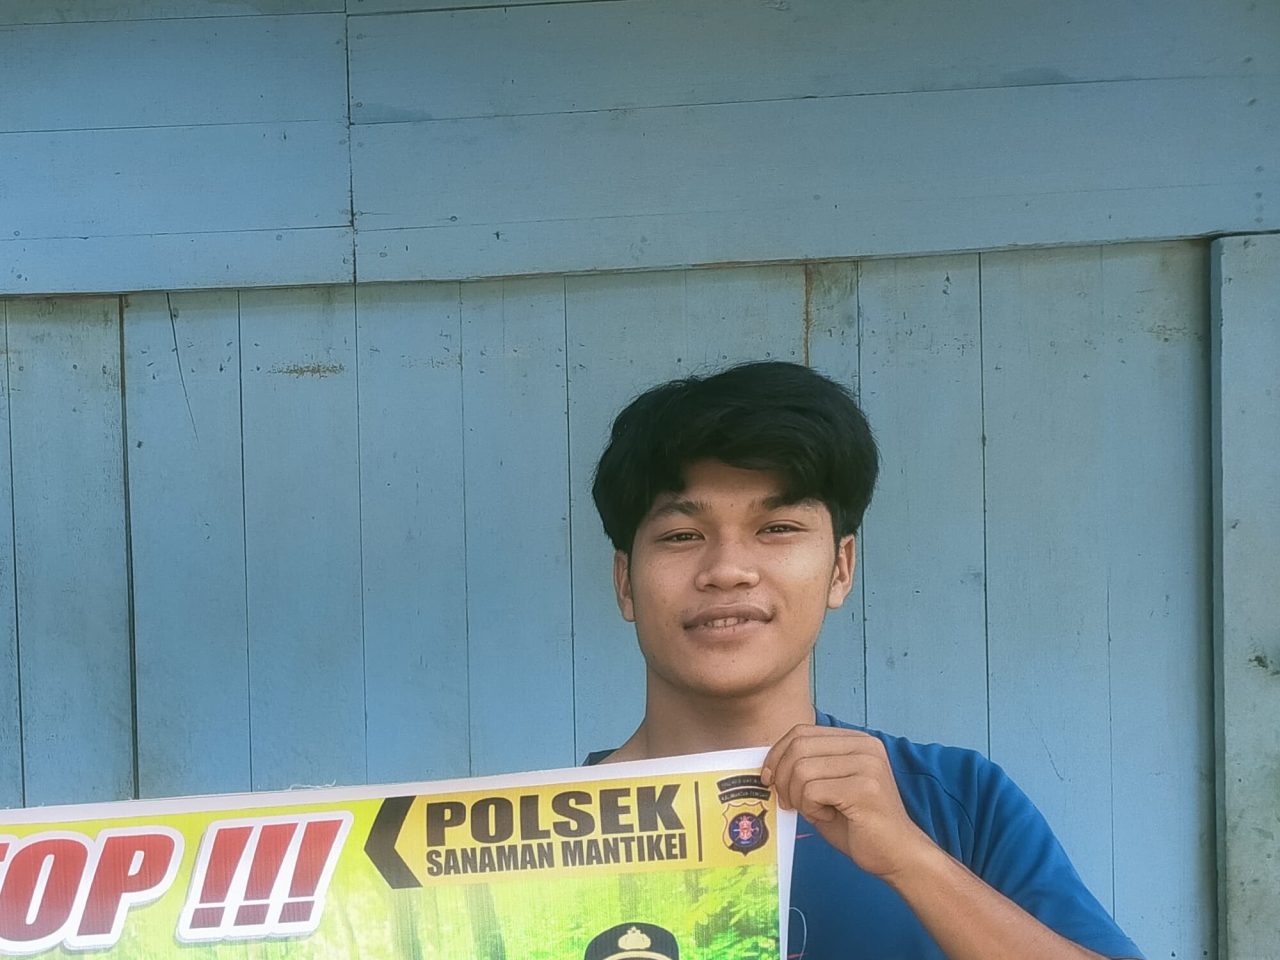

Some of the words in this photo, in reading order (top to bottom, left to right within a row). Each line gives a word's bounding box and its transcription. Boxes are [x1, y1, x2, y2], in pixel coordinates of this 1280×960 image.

[425, 783, 686, 848] POLSEK
[189, 818, 345, 930] !!!
[425, 841, 555, 877] SANAMAN
[561, 833, 688, 868] MANTIKEI
